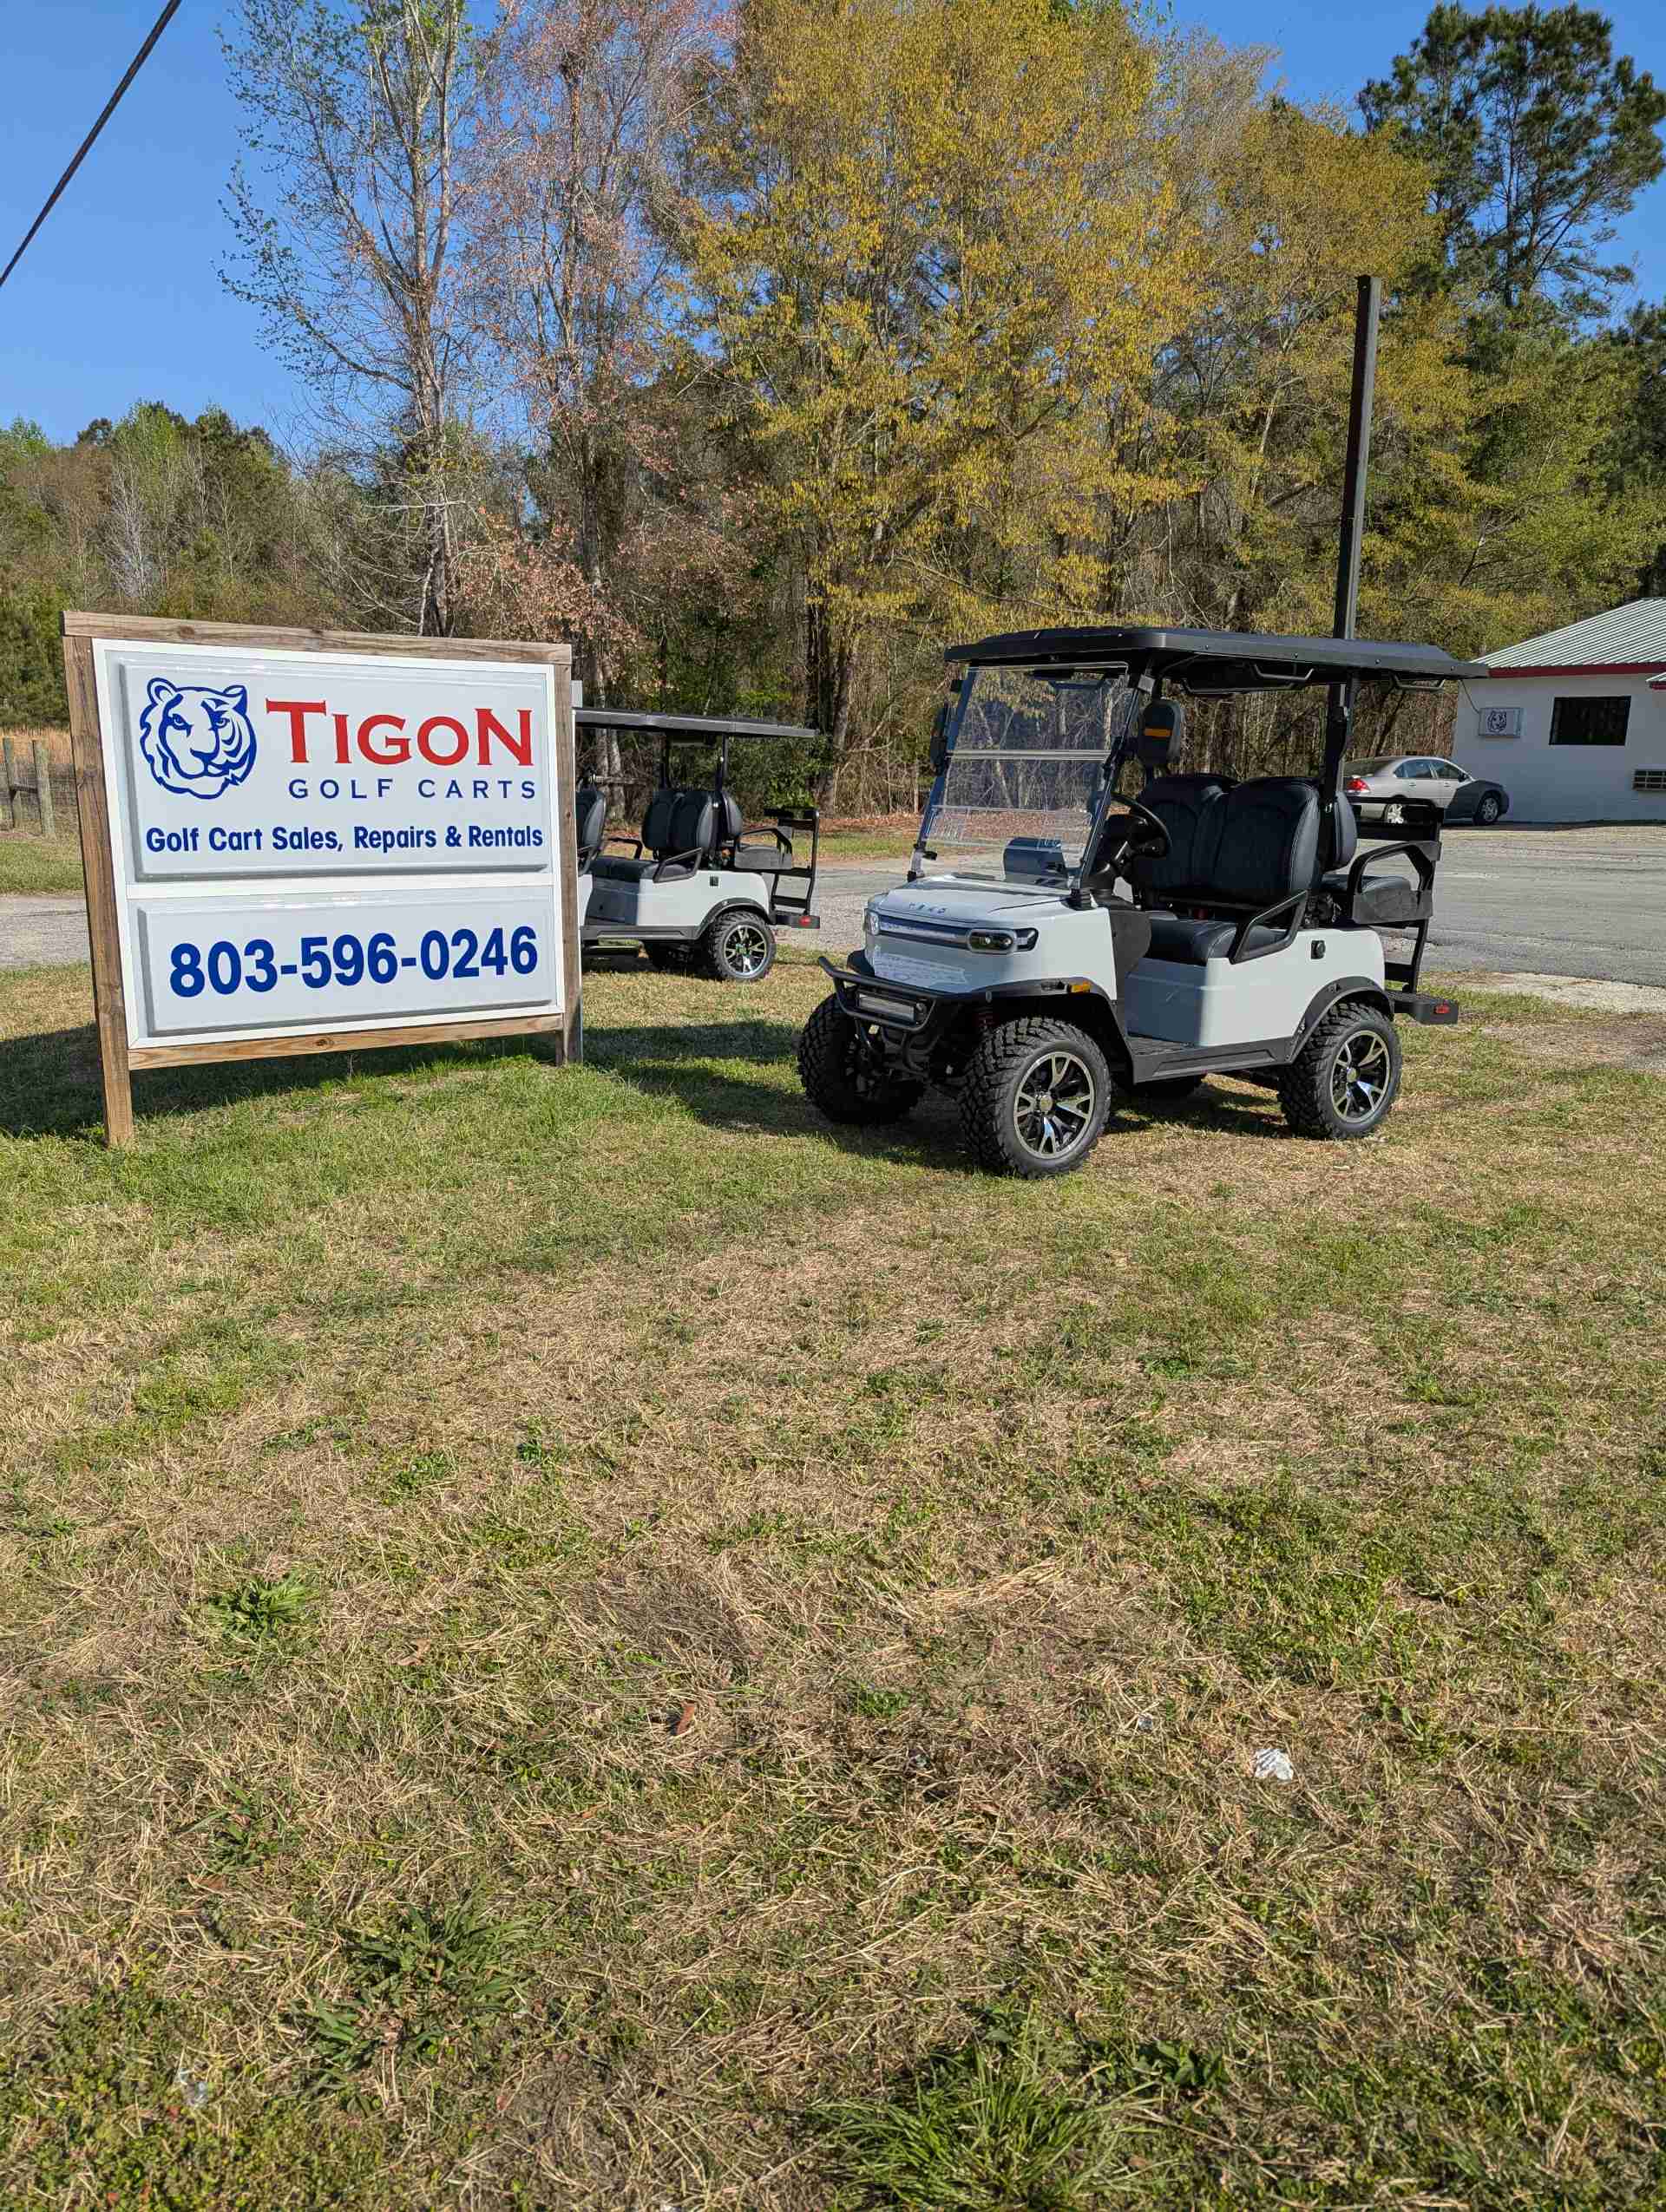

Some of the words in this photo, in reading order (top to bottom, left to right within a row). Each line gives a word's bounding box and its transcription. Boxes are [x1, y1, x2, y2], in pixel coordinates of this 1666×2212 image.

[265, 697, 533, 766] TIGON
[288, 779, 392, 799] GOLF
[417, 779, 535, 799] CARTS
[146, 827, 200, 853] Golf
[208, 827, 262, 852] Cart
[272, 826, 344, 852] Sales,
[353, 826, 436, 854] Repairs
[444, 825, 462, 847] &
[468, 825, 543, 847] Rentals
[170, 926, 538, 998] 803-596-0246
